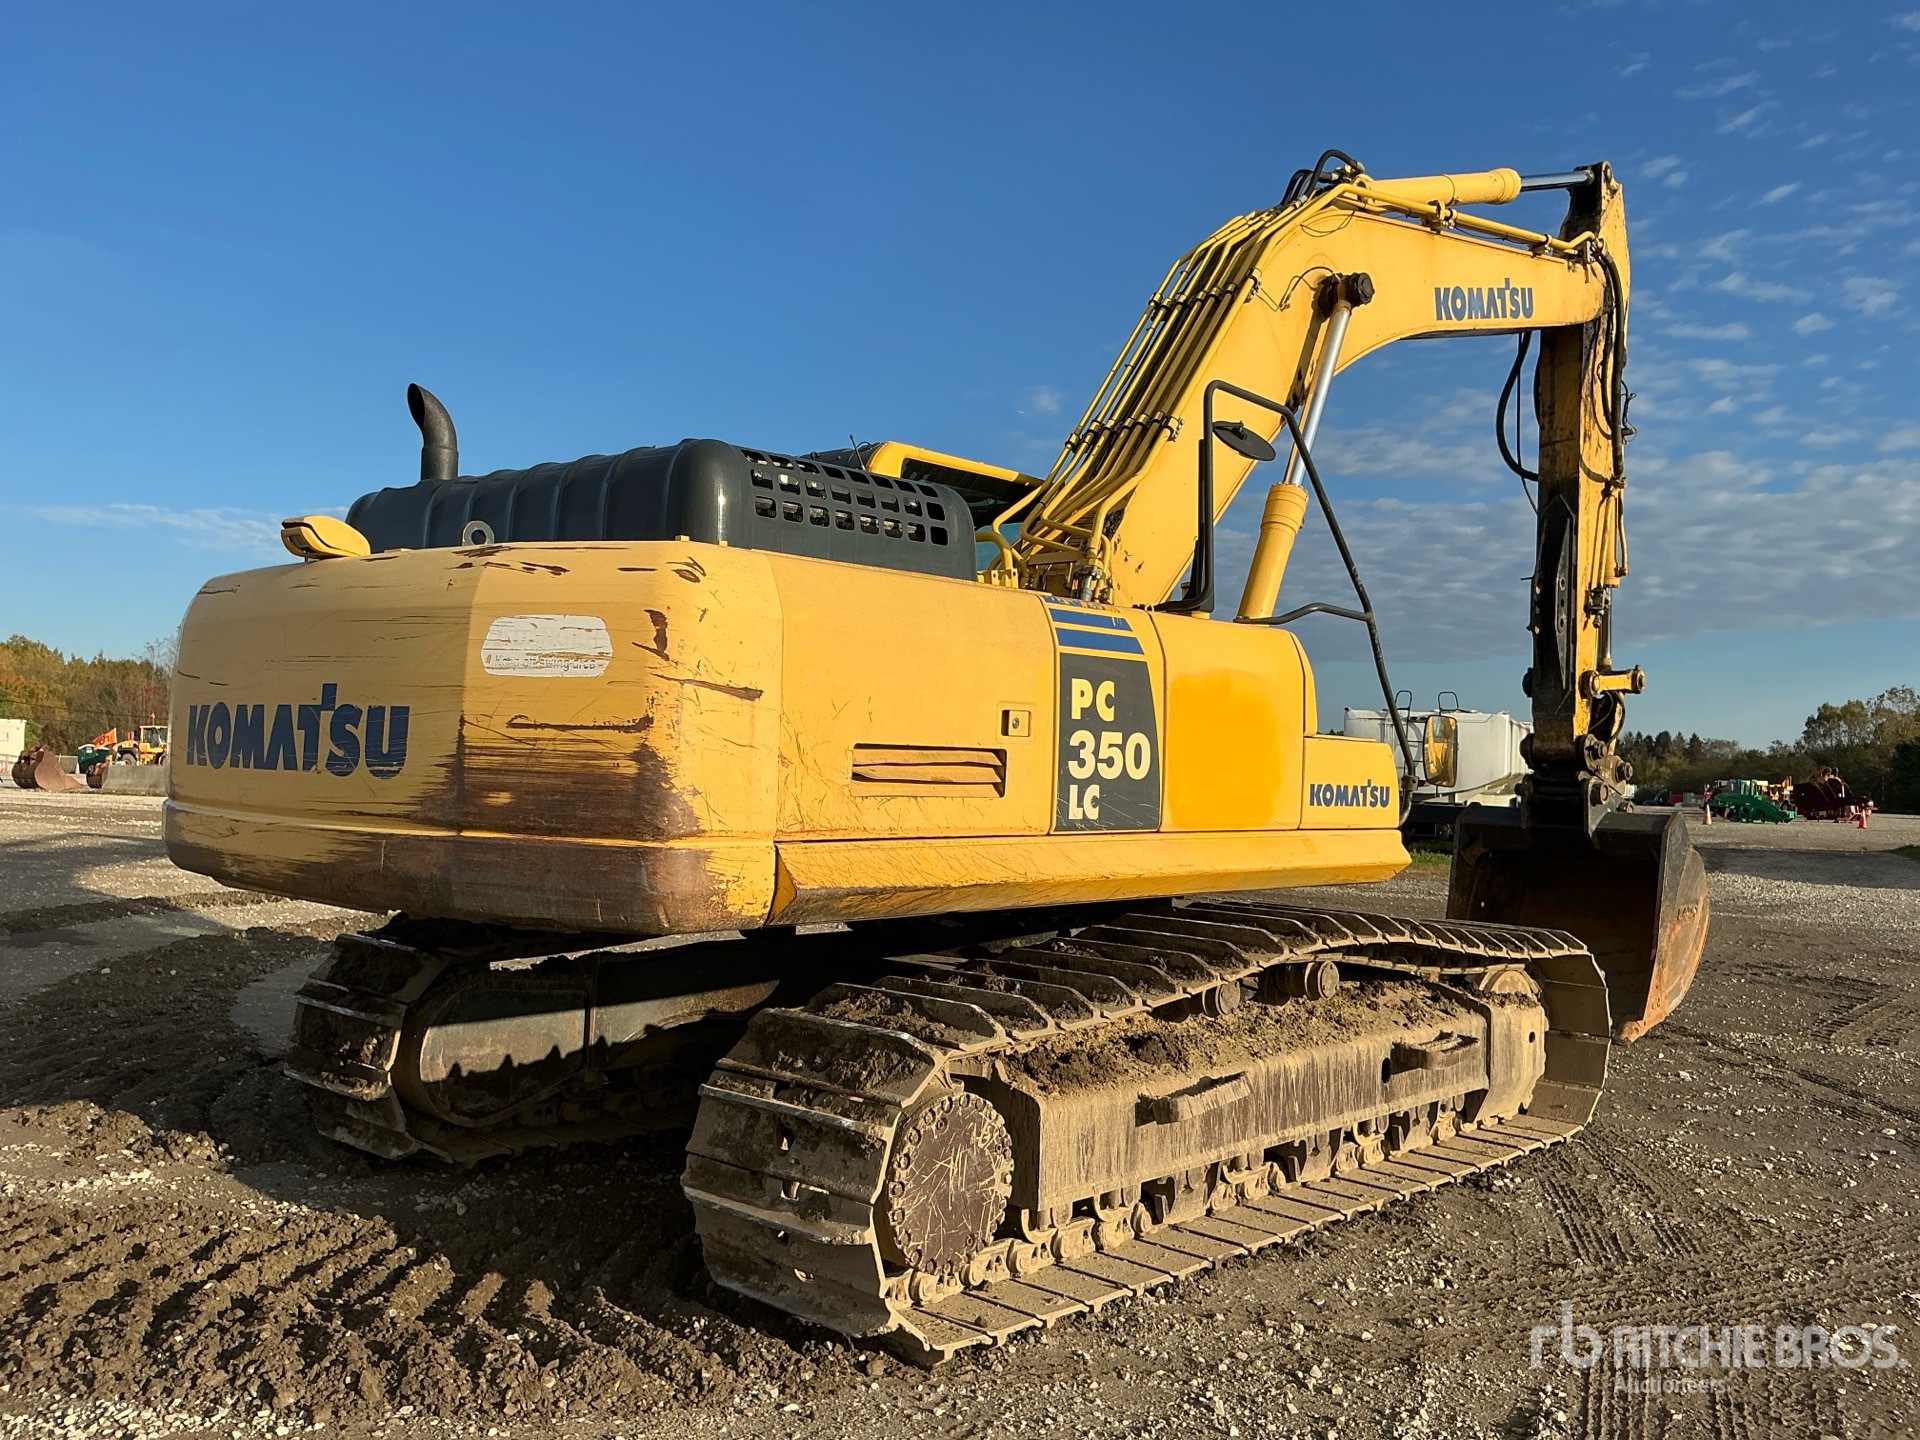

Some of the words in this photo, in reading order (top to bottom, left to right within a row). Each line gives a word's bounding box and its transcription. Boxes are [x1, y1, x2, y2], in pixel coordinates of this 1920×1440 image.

[1434, 277, 1534, 321] KOMATSU
[1071, 678, 1115, 721] PC
[186, 683, 410, 779] KOMATSU
[1068, 730, 1150, 780] 350
[1068, 784, 1100, 820] LC
[1309, 778, 1390, 808] KOMATSU
